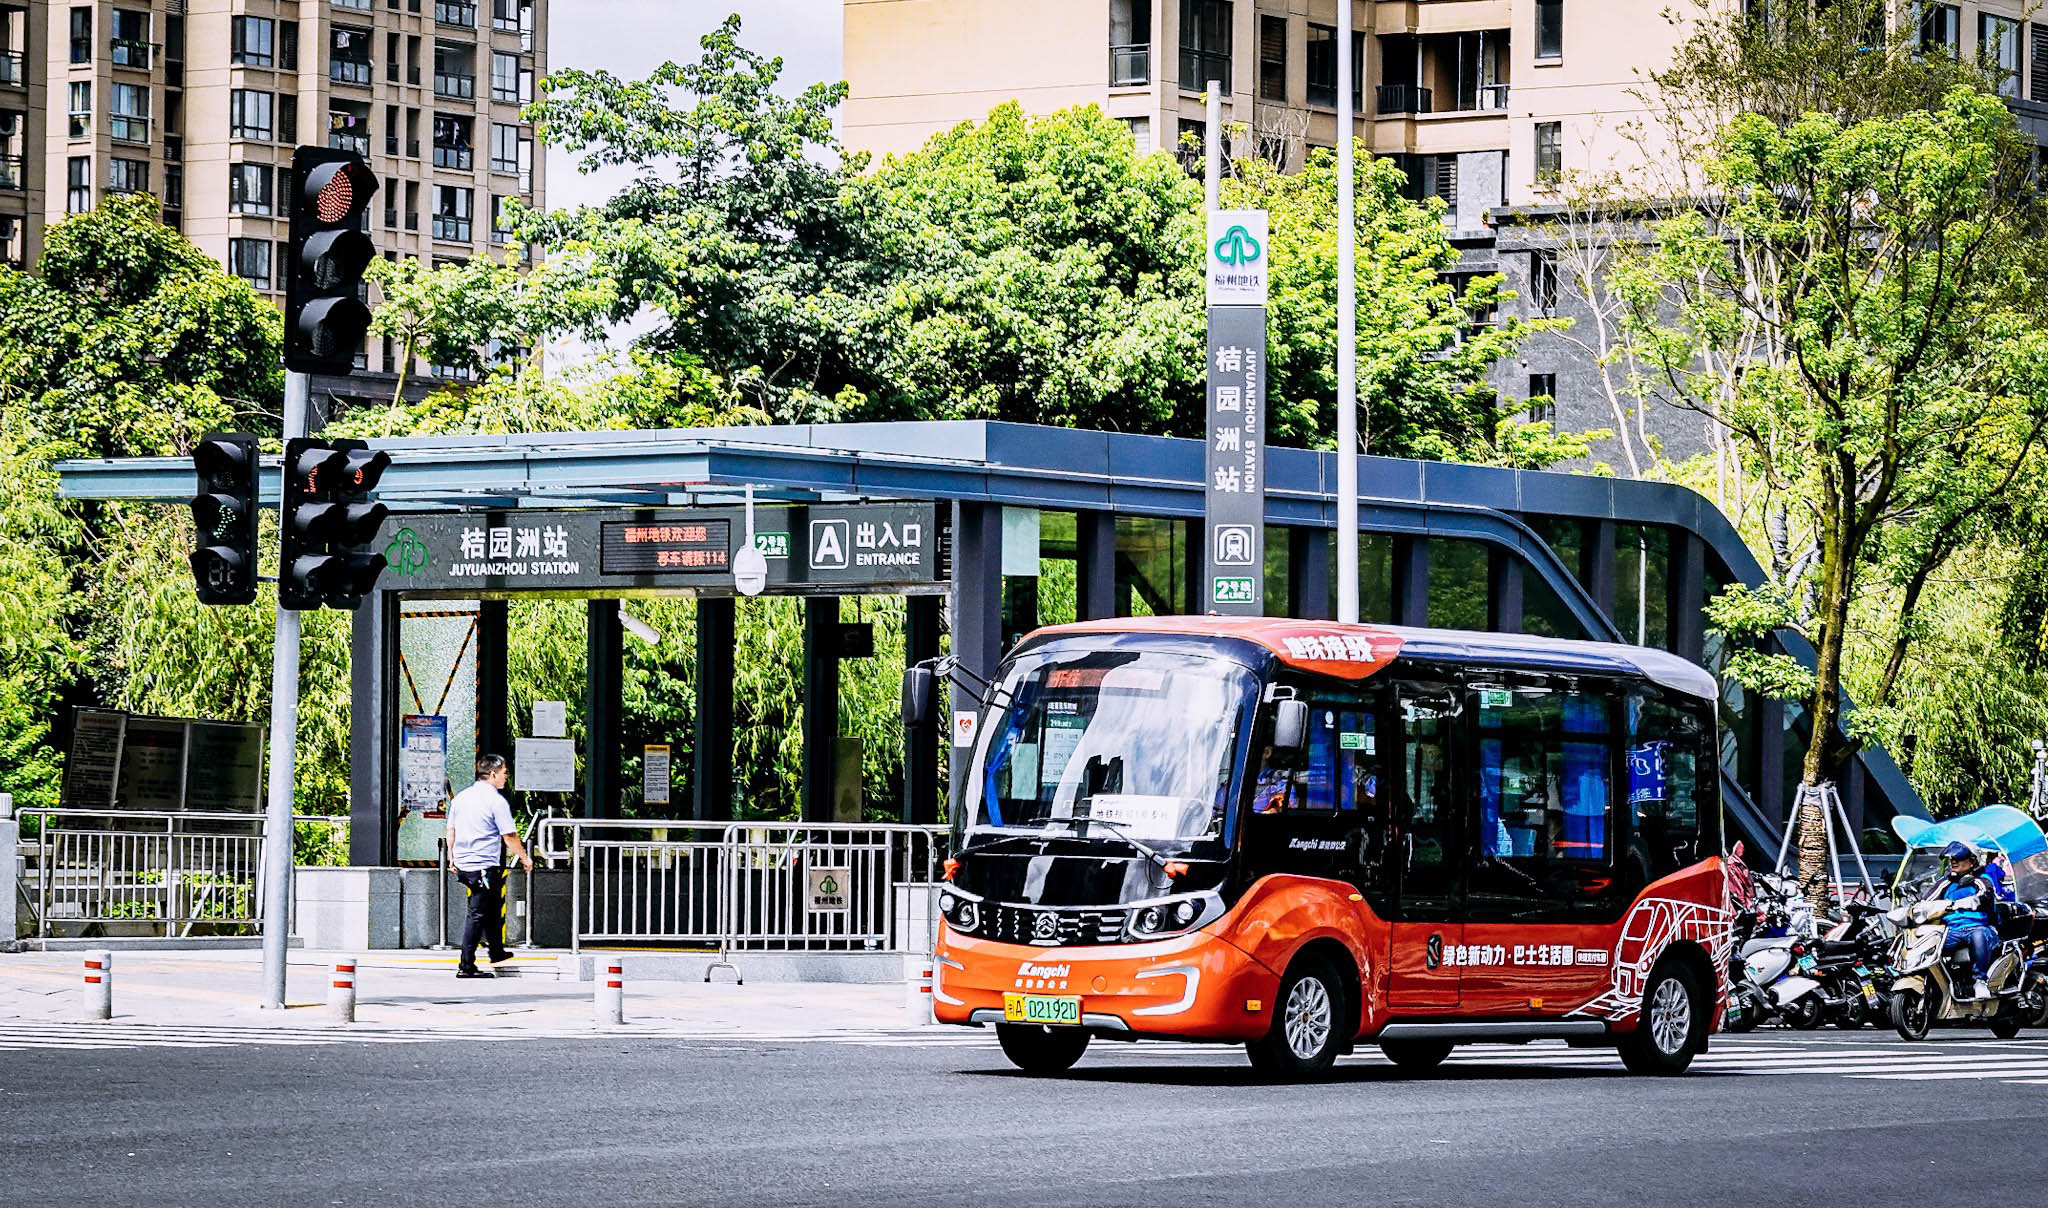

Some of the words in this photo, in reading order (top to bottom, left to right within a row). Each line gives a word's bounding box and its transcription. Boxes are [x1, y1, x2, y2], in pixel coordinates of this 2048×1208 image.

[1215, 274, 1260, 287] 福州地铁
[1244, 347, 1257, 434] JUYUANZHOU
[1214, 345, 1242, 494] 桔园洲站
[1244, 440, 1257, 494] STATION
[460, 525, 569, 560] 桔园洲站
[624, 526, 707, 543] 福州地铁欢迎您
[814, 525, 844, 563] A
[856, 522, 921, 549] 出入口
[756, 535, 787, 555] 2号线
[448, 562, 528, 577] JUYUANZHOU
[530, 561, 580, 576] STATION
[856, 552, 921, 566] ENTRANCE
[1289, 838, 1319, 851] Kangchi
[814, 896, 843, 905] 福州地铁
[1017, 961, 1071, 979] Kangchi
[1028, 999, 1077, 1020] 02192D
